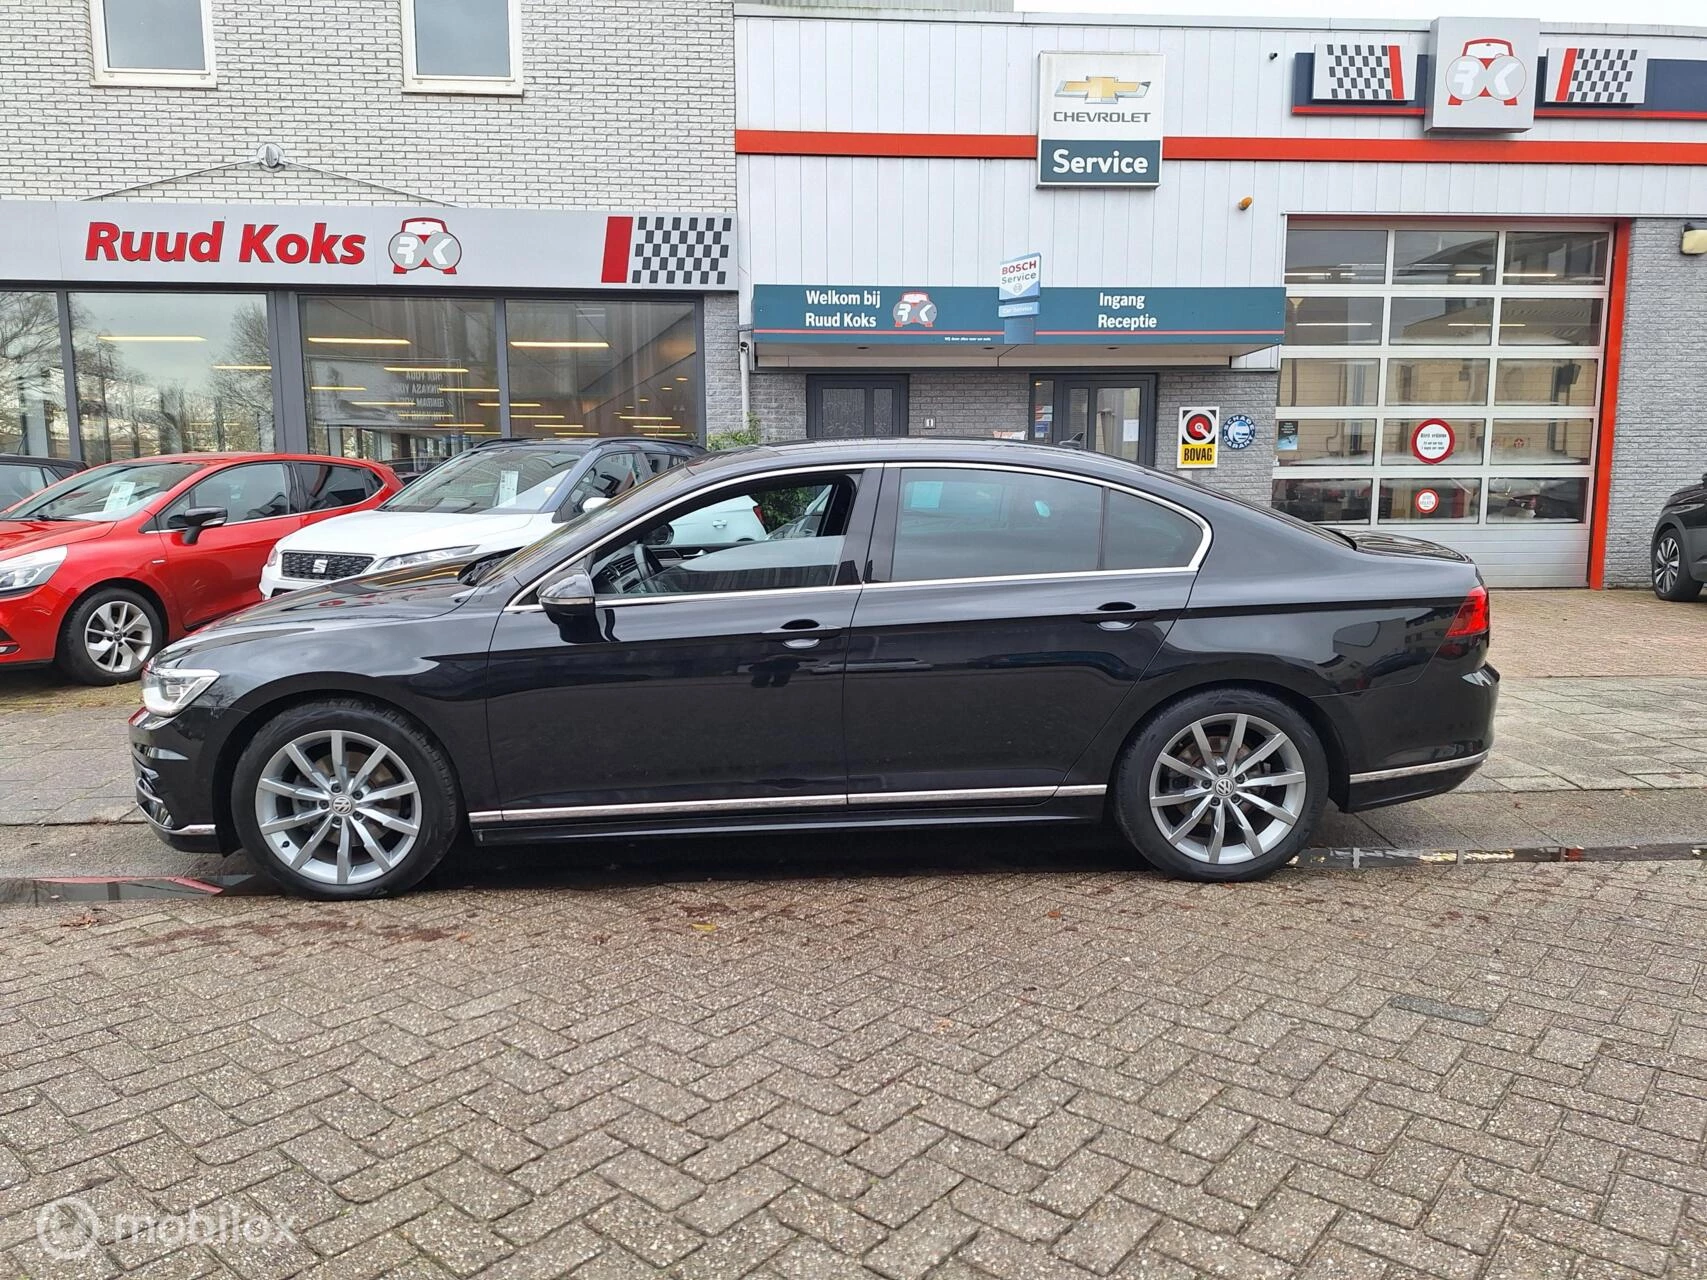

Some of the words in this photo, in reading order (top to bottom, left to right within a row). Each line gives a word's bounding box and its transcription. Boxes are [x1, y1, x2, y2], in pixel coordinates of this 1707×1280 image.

[1053, 111, 1151, 122] CHEVROLET
[1052, 148, 1149, 174] Service
[85, 220, 225, 262] Ruud
[238, 222, 367, 265] Koks
[1001, 260, 1037, 276] BOSCH
[1001, 271, 1037, 285] Service
[805, 290, 861, 305] Welkom
[863, 290, 881, 309] bij
[1099, 292, 1145, 310] Ingang
[805, 312, 841, 328] Ruud
[843, 313, 877, 328] Koks
[1098, 314, 1158, 331] Receptie
[1223, 415, 1255, 431] SCHADE
[1183, 447, 1213, 461] BOVAG
